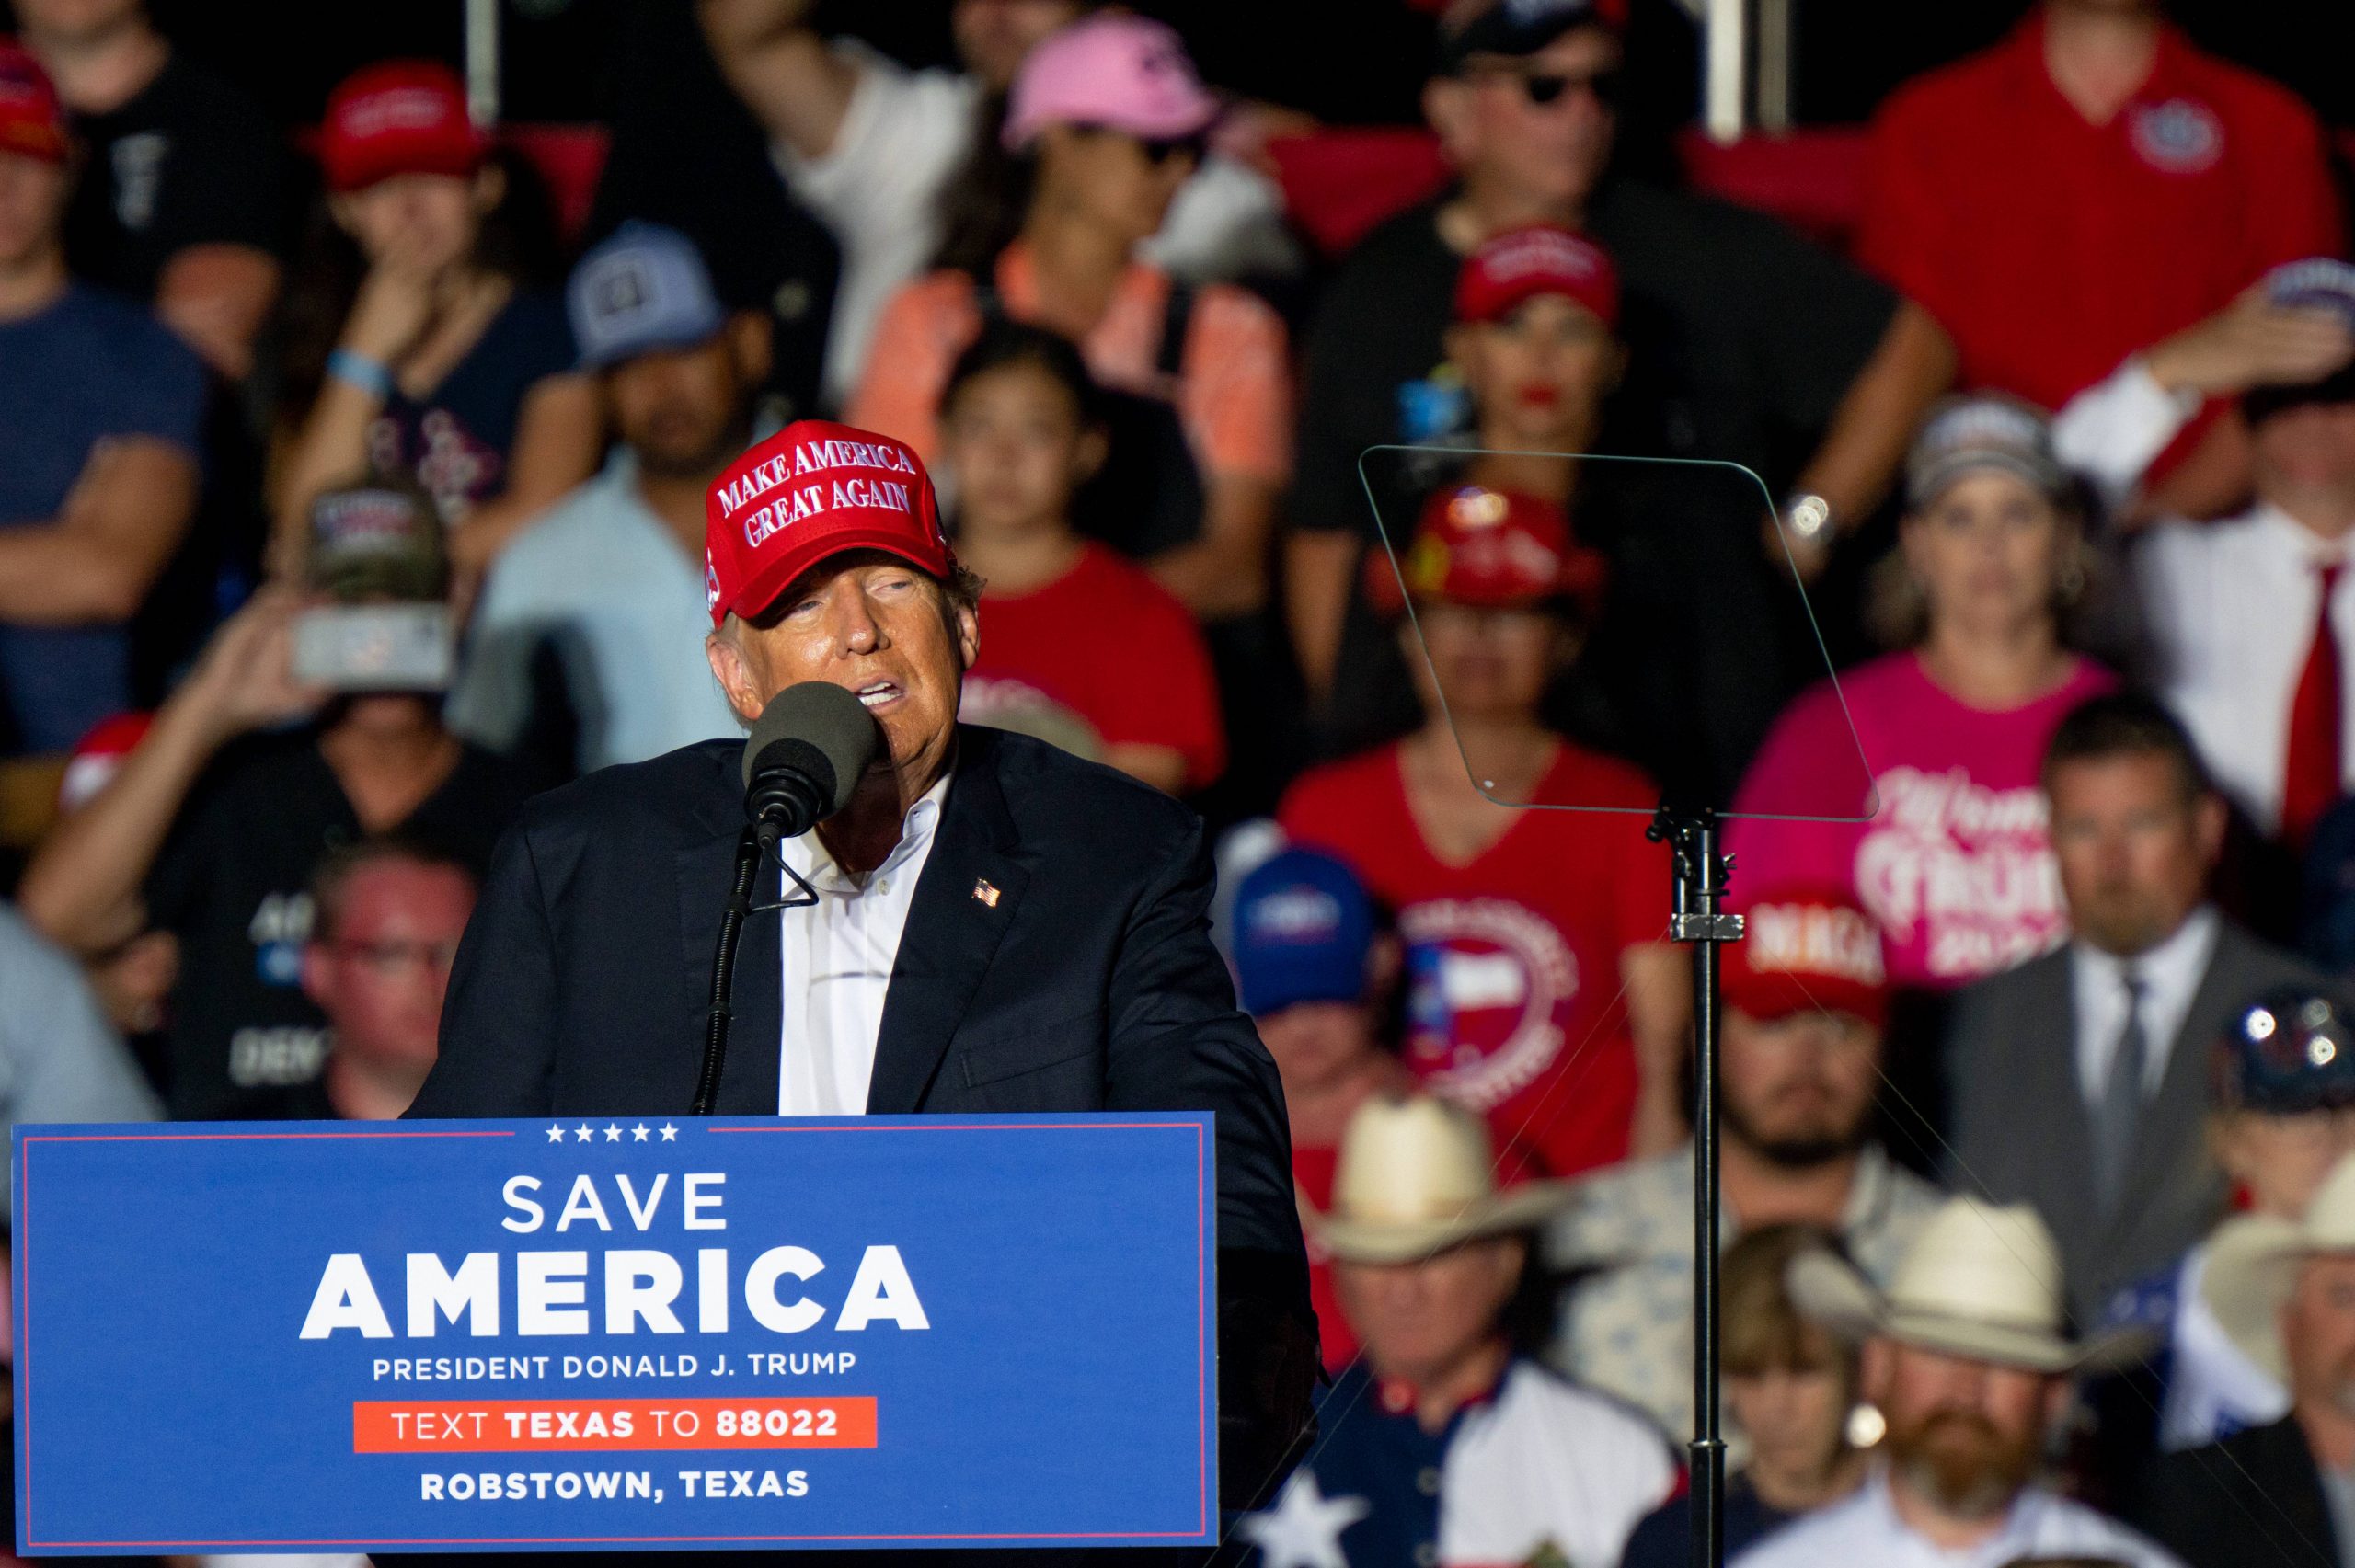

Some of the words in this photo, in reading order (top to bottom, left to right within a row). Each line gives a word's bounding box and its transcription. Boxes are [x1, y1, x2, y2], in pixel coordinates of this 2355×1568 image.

[717, 453, 791, 519] MAKE
[794, 439, 917, 476] AMERICA
[743, 484, 826, 549] GREAT
[831, 478, 912, 515] AGAIN
[1748, 903, 1886, 986] MAGA
[500, 1173, 727, 1233] SAVE
[299, 1244, 931, 1338] AMERICA
[373, 1356, 550, 1381] PRESIDENT
[563, 1354, 698, 1379] DONALD
[710, 1353, 735, 1377] J.
[747, 1352, 856, 1376] TRUMP
[390, 1413, 488, 1440] TEXT
[503, 1411, 635, 1438] TEXAS
[649, 1410, 700, 1438] TO
[715, 1408, 838, 1437] 88022
[421, 1471, 664, 1504] ROBSTOWN,
[678, 1470, 810, 1498] TEXAS
